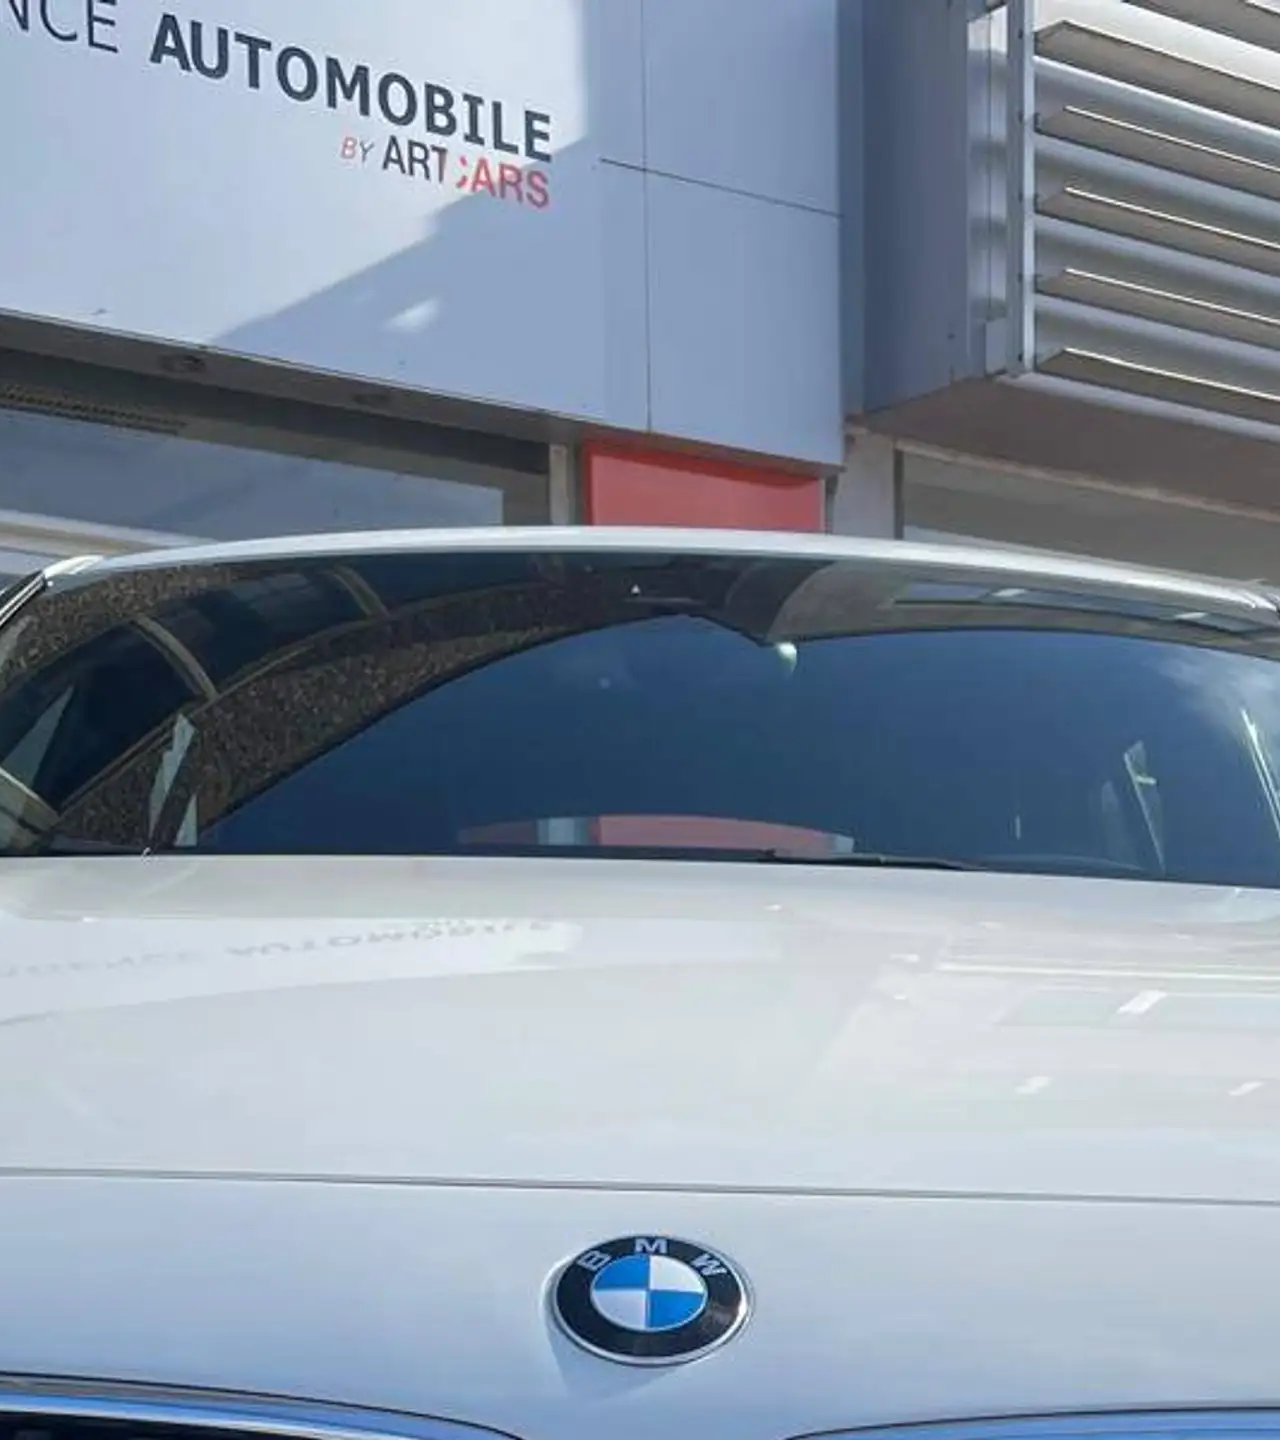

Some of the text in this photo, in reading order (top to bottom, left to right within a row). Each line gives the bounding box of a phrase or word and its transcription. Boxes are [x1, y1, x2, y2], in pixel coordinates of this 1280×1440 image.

[149, 12, 552, 162] AUTOMOBILE
[340, 135, 375, 164] BY
[576, 1238, 728, 1276] BMW
